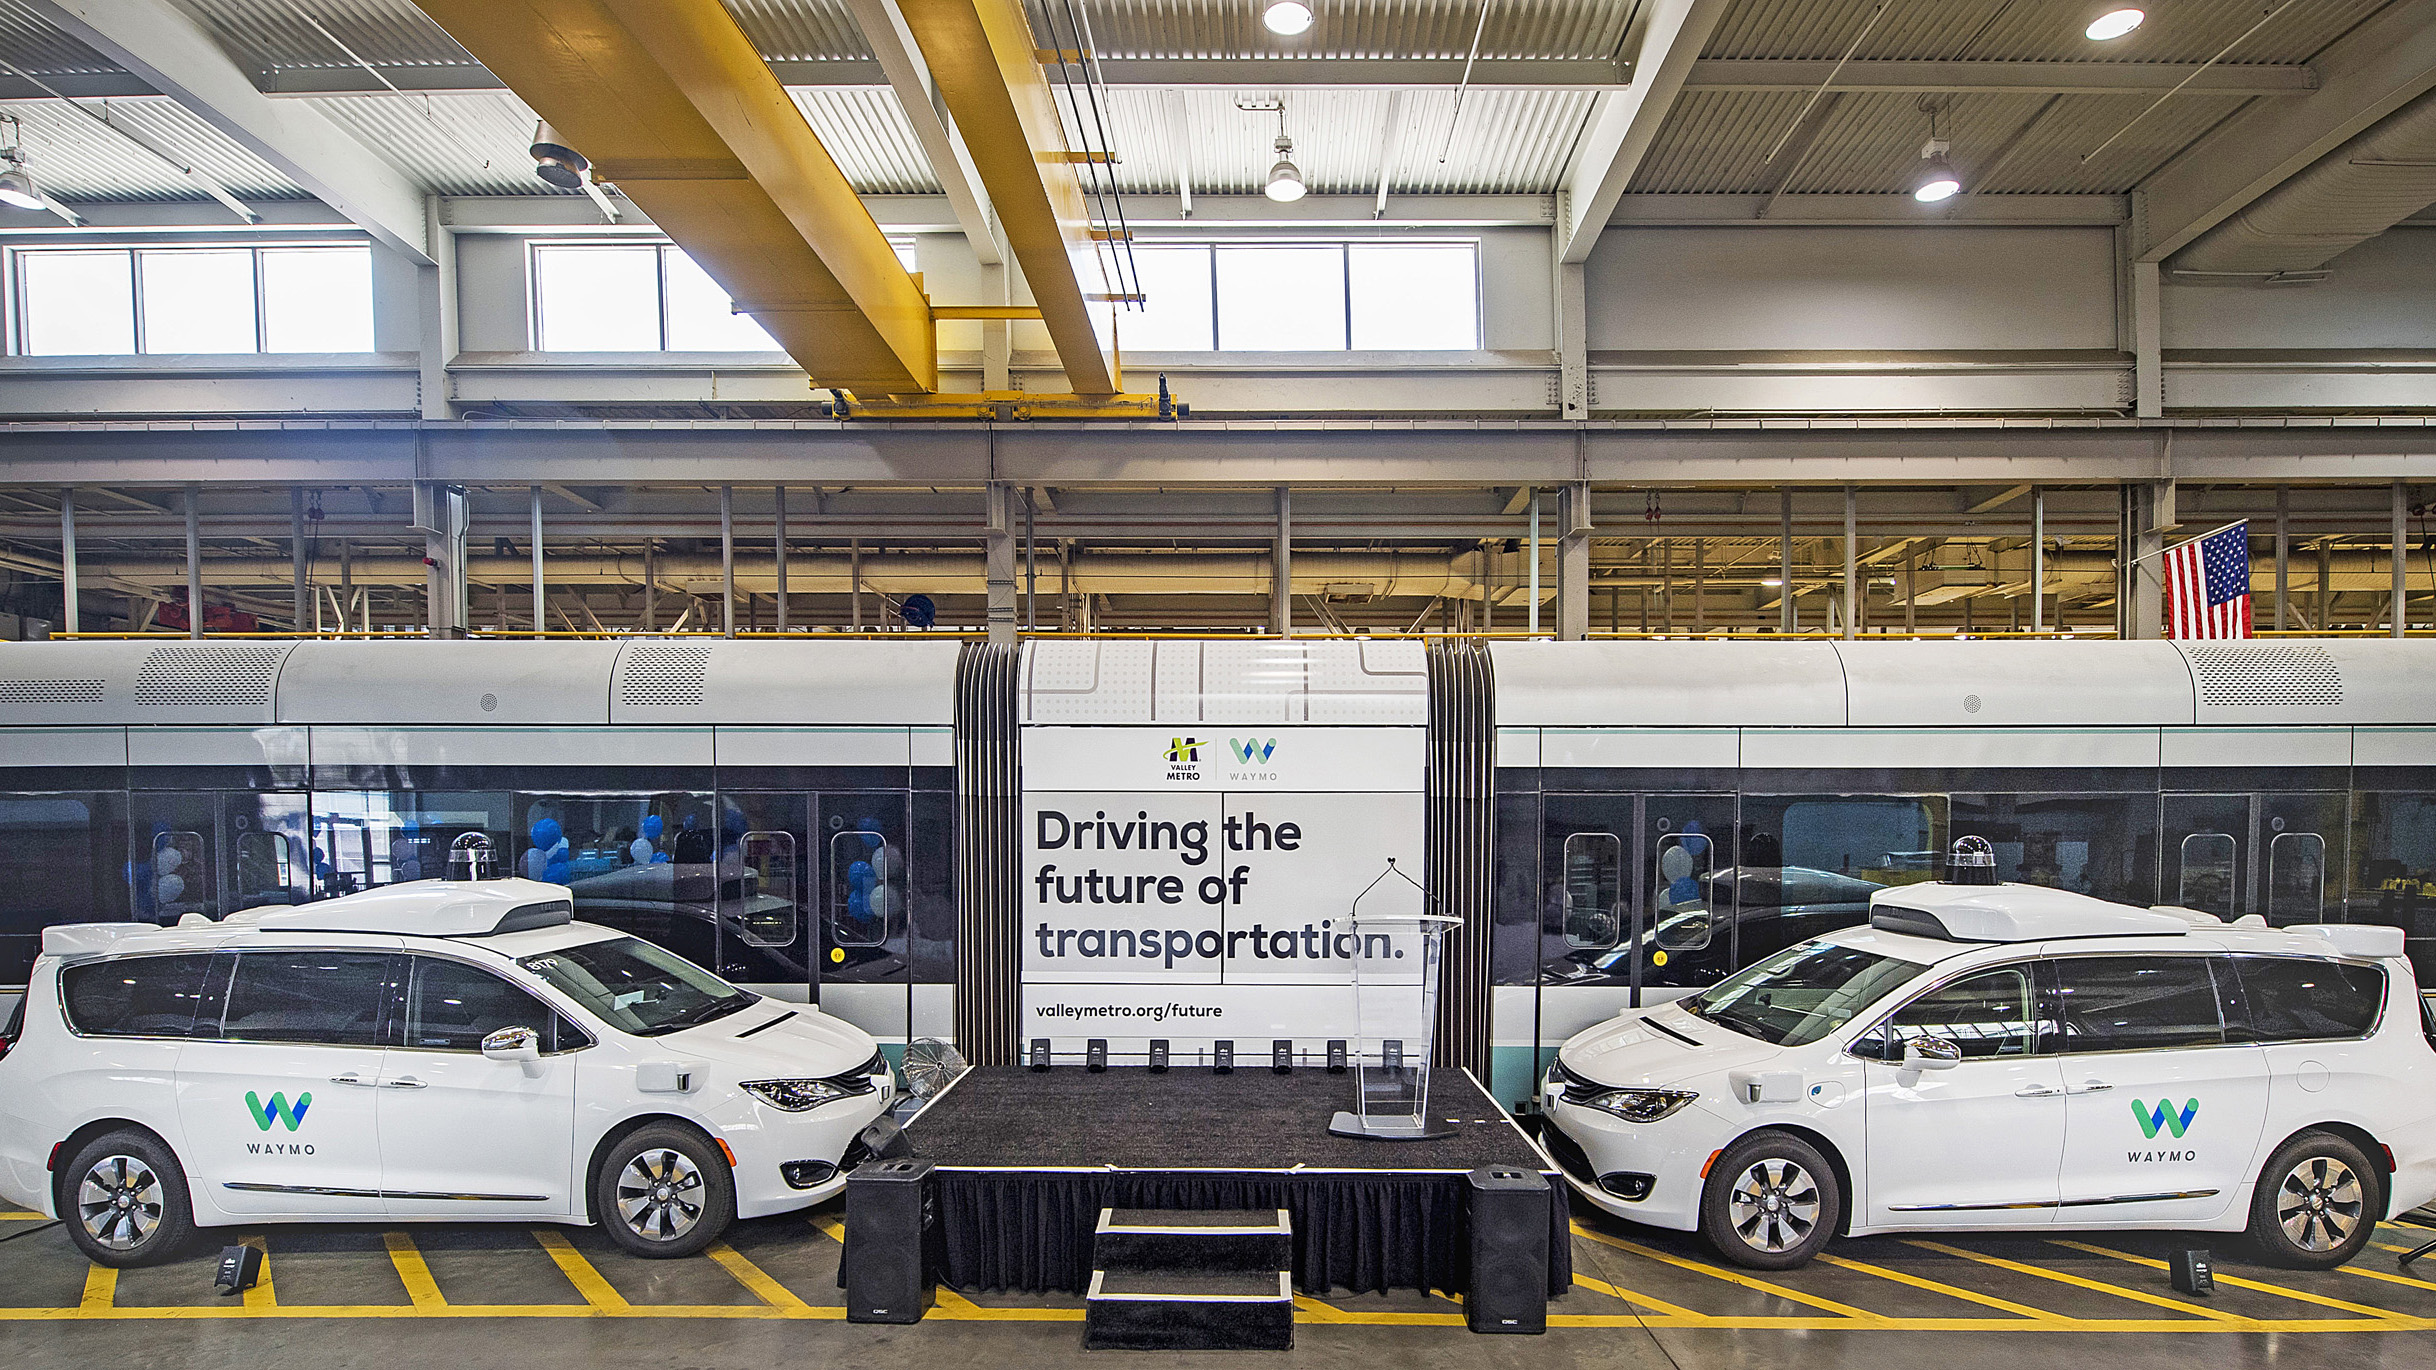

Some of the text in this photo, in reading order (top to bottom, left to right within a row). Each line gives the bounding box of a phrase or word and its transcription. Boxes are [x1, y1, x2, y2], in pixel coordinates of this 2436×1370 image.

[1166, 772, 1200, 781] METRO
[1229, 772, 1278, 781] WAYMO
[1036, 810, 1302, 866] Driving the
[1034, 864, 1251, 905] future of
[1034, 918, 1405, 970] transportation.
[1035, 1003, 1223, 1020] valleymetro.org/future
[246, 1143, 316, 1156] WAYMO
[2127, 1150, 2197, 1163] WAYMO
